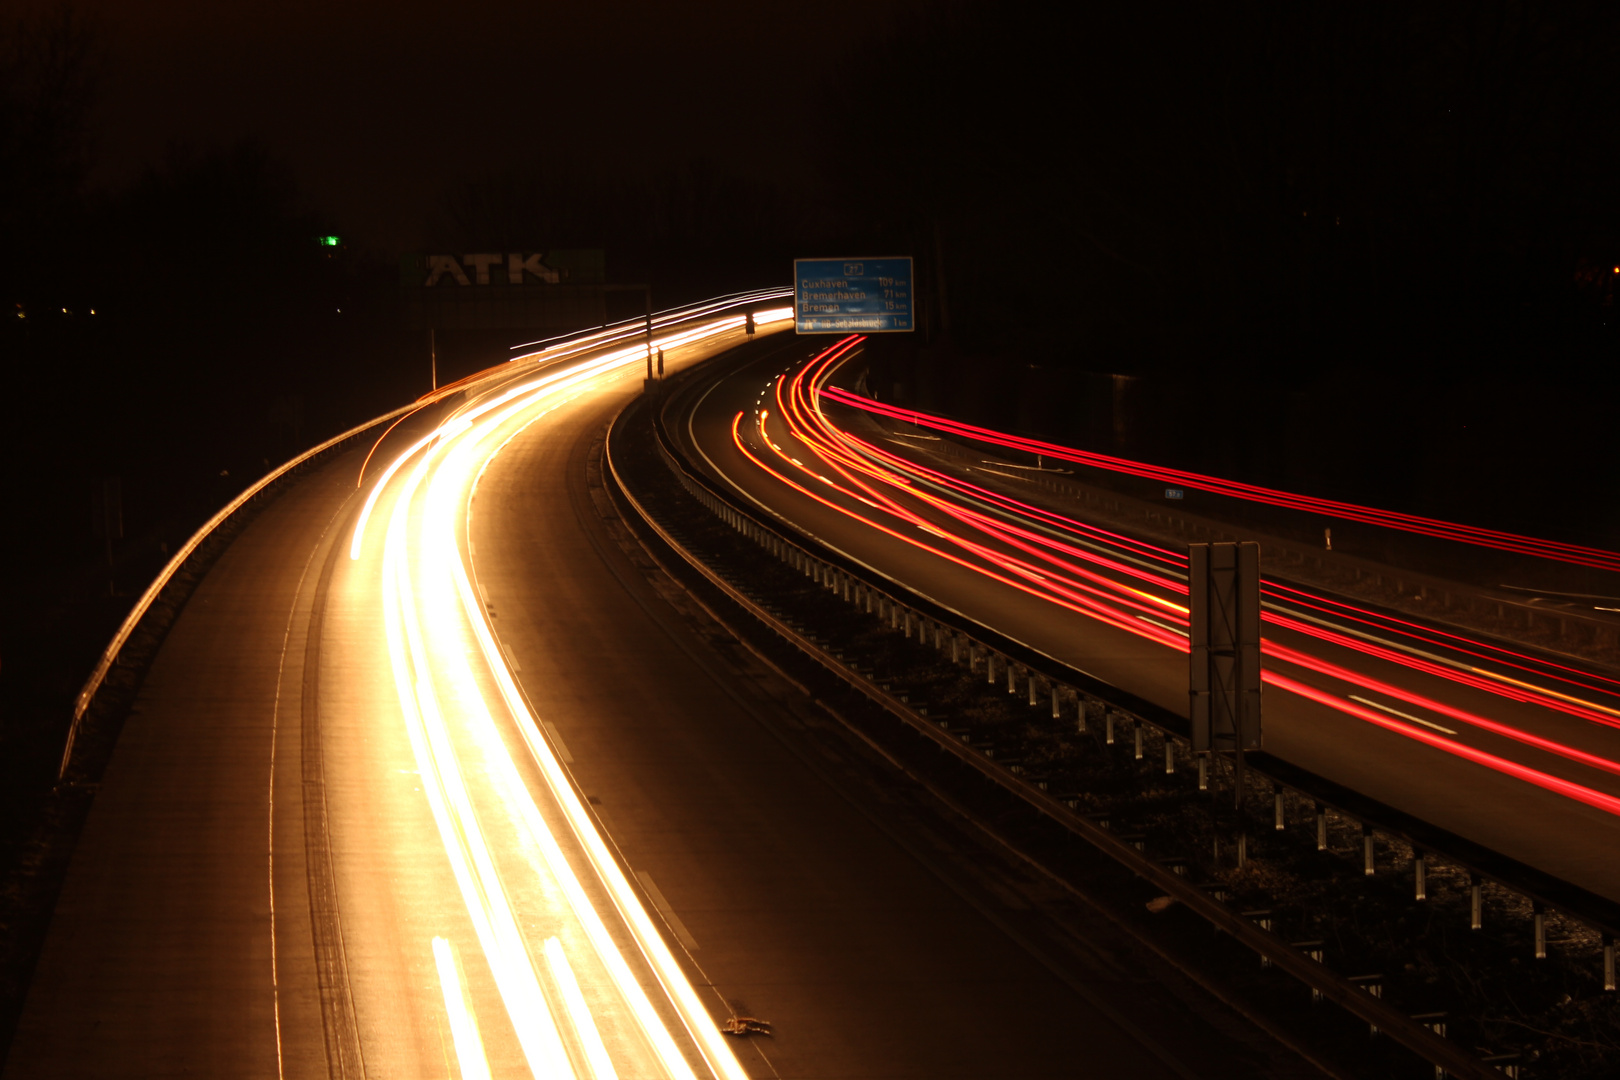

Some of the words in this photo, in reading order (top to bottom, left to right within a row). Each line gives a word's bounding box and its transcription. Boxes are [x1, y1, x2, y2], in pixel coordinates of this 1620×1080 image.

[802, 279, 848, 289] Cuxhaven
[879, 277, 893, 287] 109
[895, 279, 907, 287] km
[802, 291, 866, 301] Bremerhaven
[884, 289, 893, 298] 71
[802, 303, 840, 312] Bremen
[885, 301, 895, 310] 15
[898, 319, 907, 327] km
